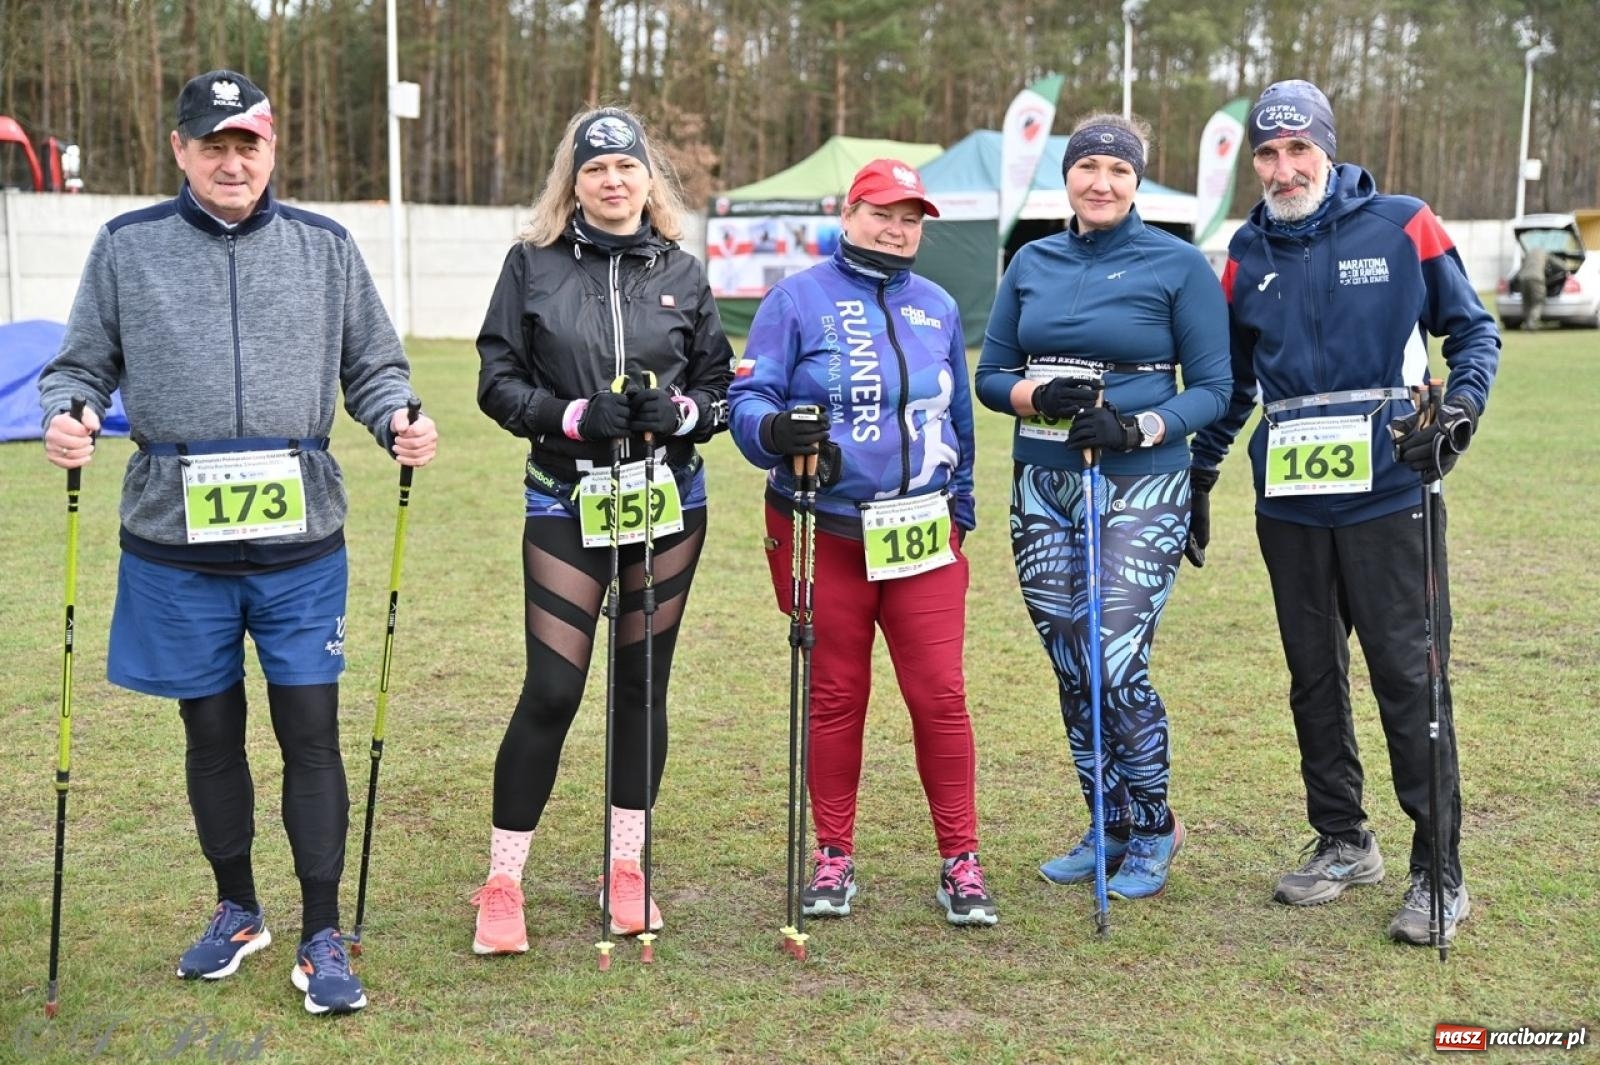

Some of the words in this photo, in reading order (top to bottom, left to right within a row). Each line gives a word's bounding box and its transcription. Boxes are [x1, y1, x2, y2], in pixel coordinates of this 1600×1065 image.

[1265, 104, 1297, 114] ULTRA
[1267, 111, 1308, 124] ZADEK
[1338, 257, 1387, 271] MARATONA
[835, 300, 882, 443] RUNNERS
[828, 383, 845, 424] TEAM
[1282, 444, 1355, 481] 163
[204, 482, 288, 525] 173
[595, 487, 666, 531] 159
[881, 520, 940, 564] 181
